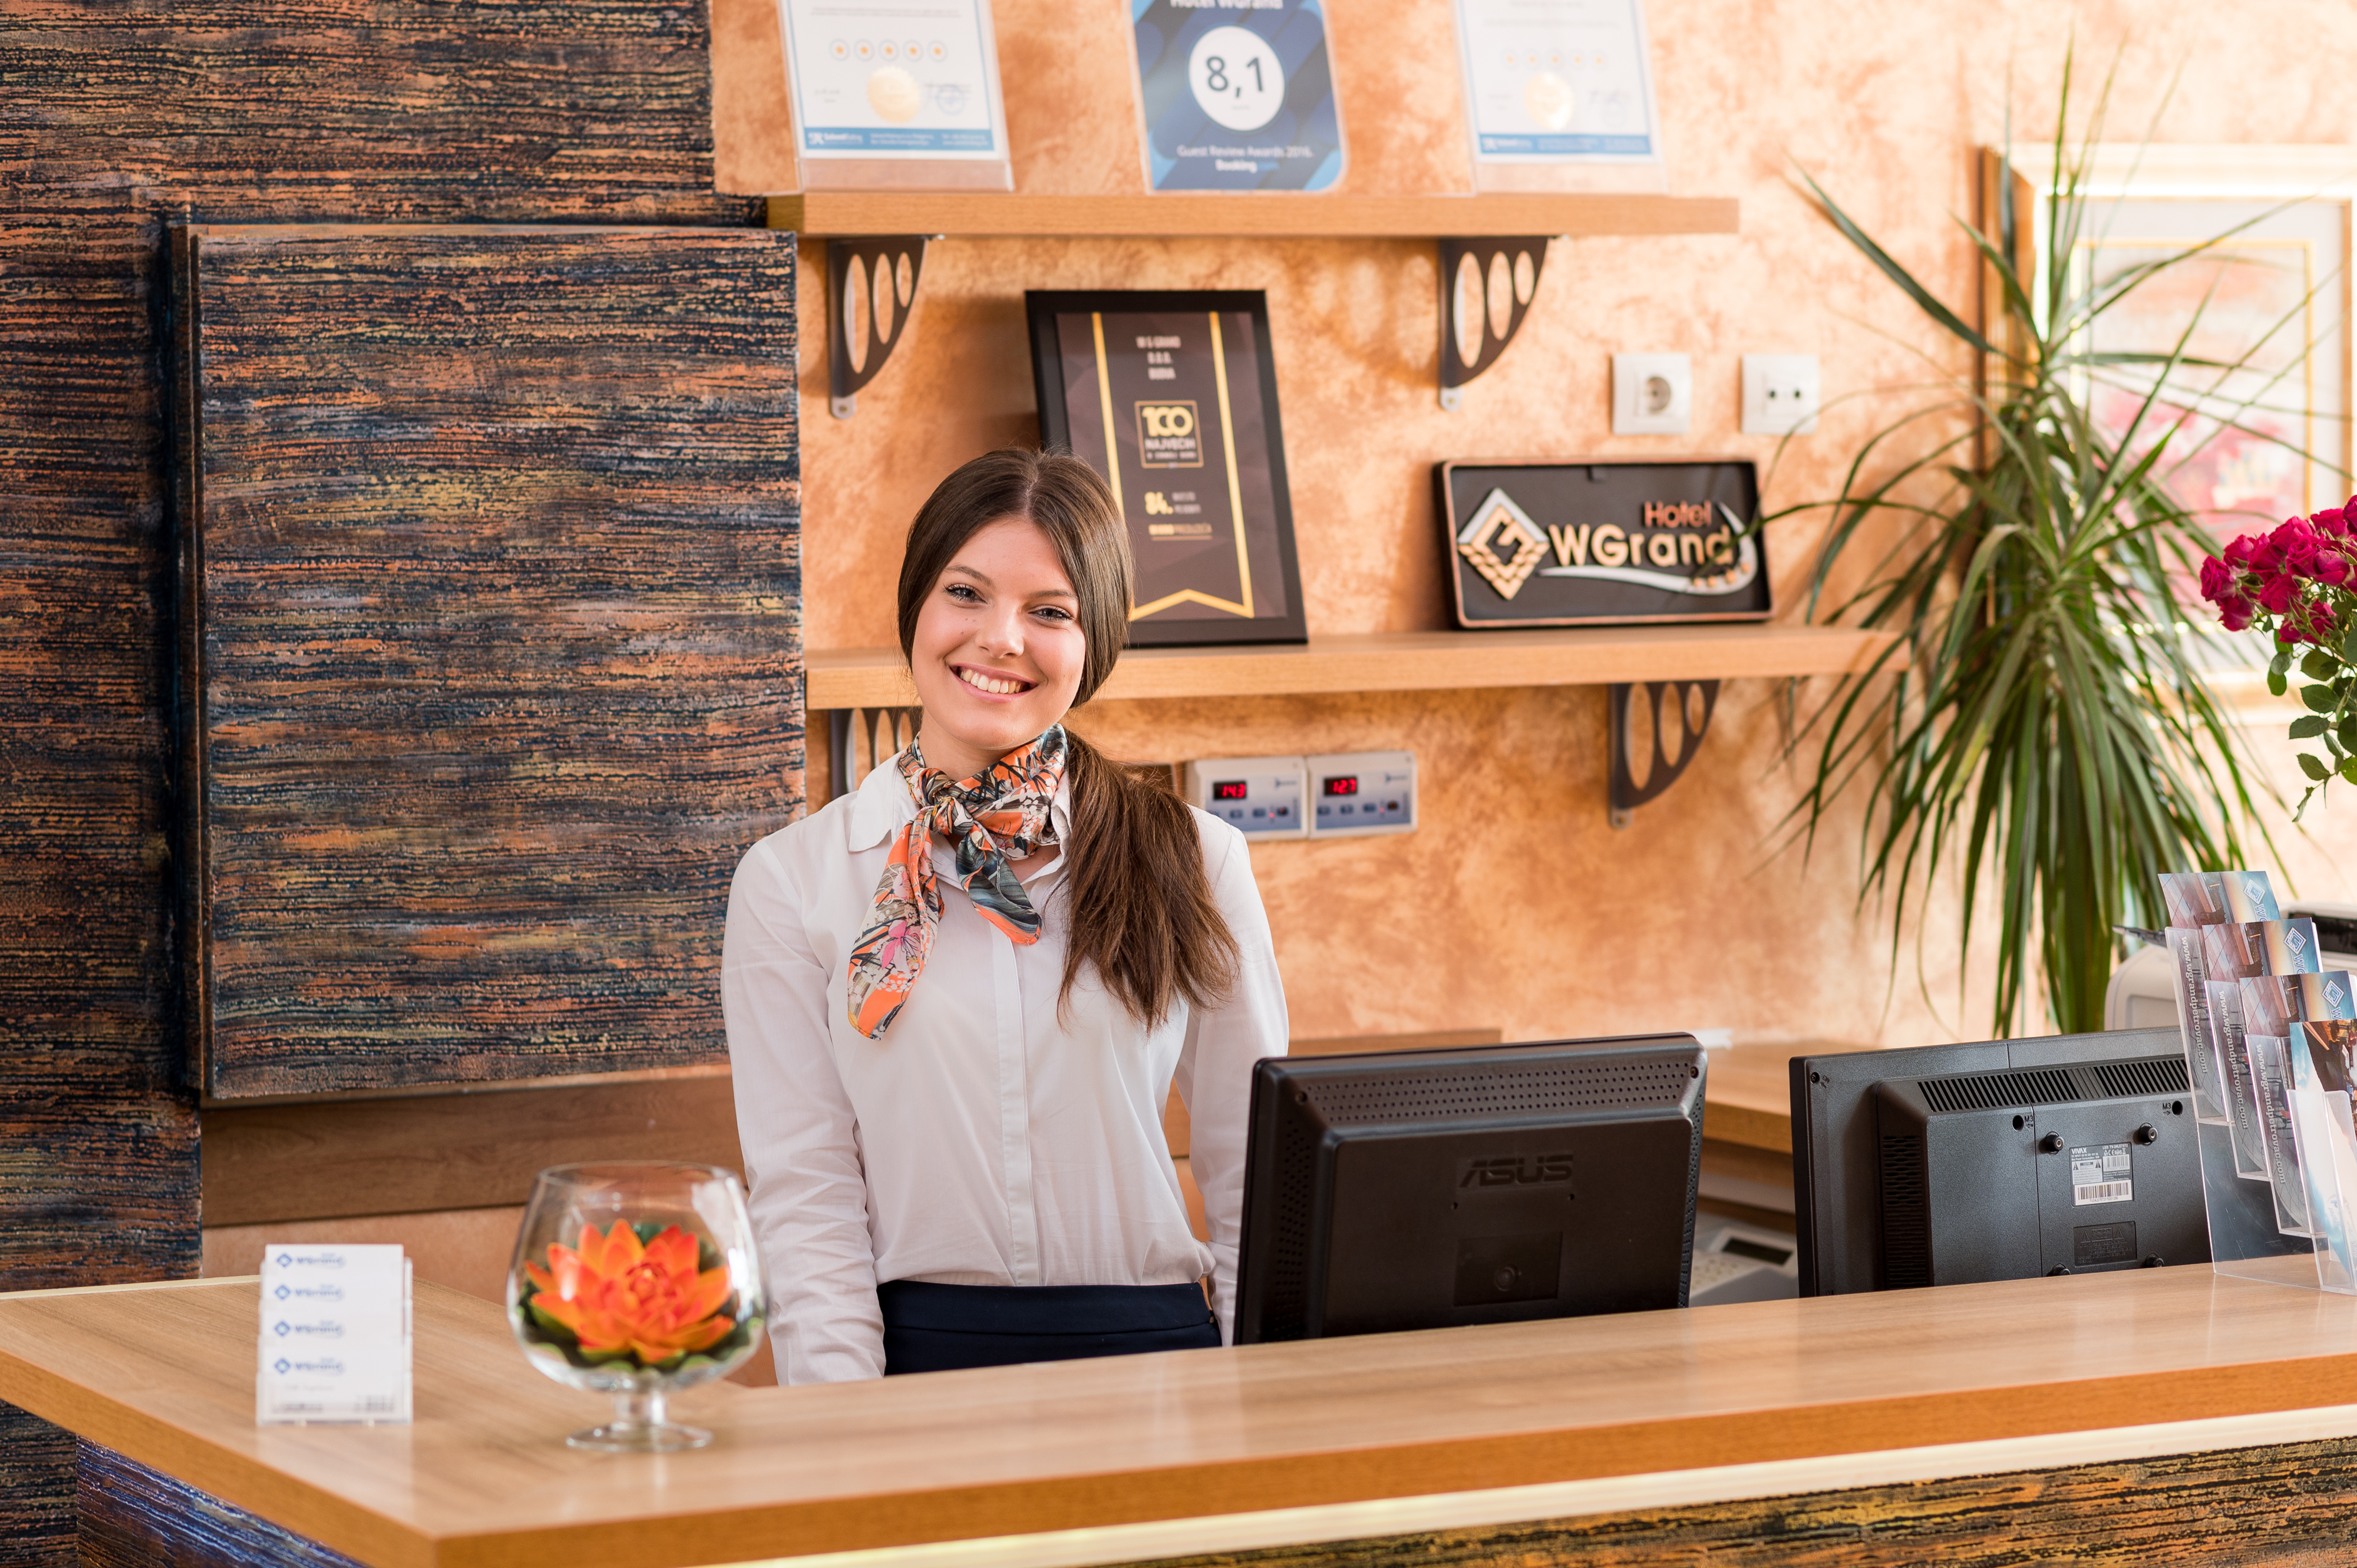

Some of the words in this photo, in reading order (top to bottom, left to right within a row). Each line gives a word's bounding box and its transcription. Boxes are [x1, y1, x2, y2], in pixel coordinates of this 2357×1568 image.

[1206, 57, 1263, 98] 8,1
[1142, 407, 1194, 437] 100
[1644, 500, 1711, 528] Hotel
[1548, 524, 1734, 567] WGrand
[2181, 936, 2208, 1074] www.wgrandpetrovac.com
[2219, 991, 2248, 1130] www.wgrandpetrovac.com
[2256, 1044, 2285, 1183] www.wgrandpetrovac.com
[1459, 1154, 1573, 1188] ASUS
